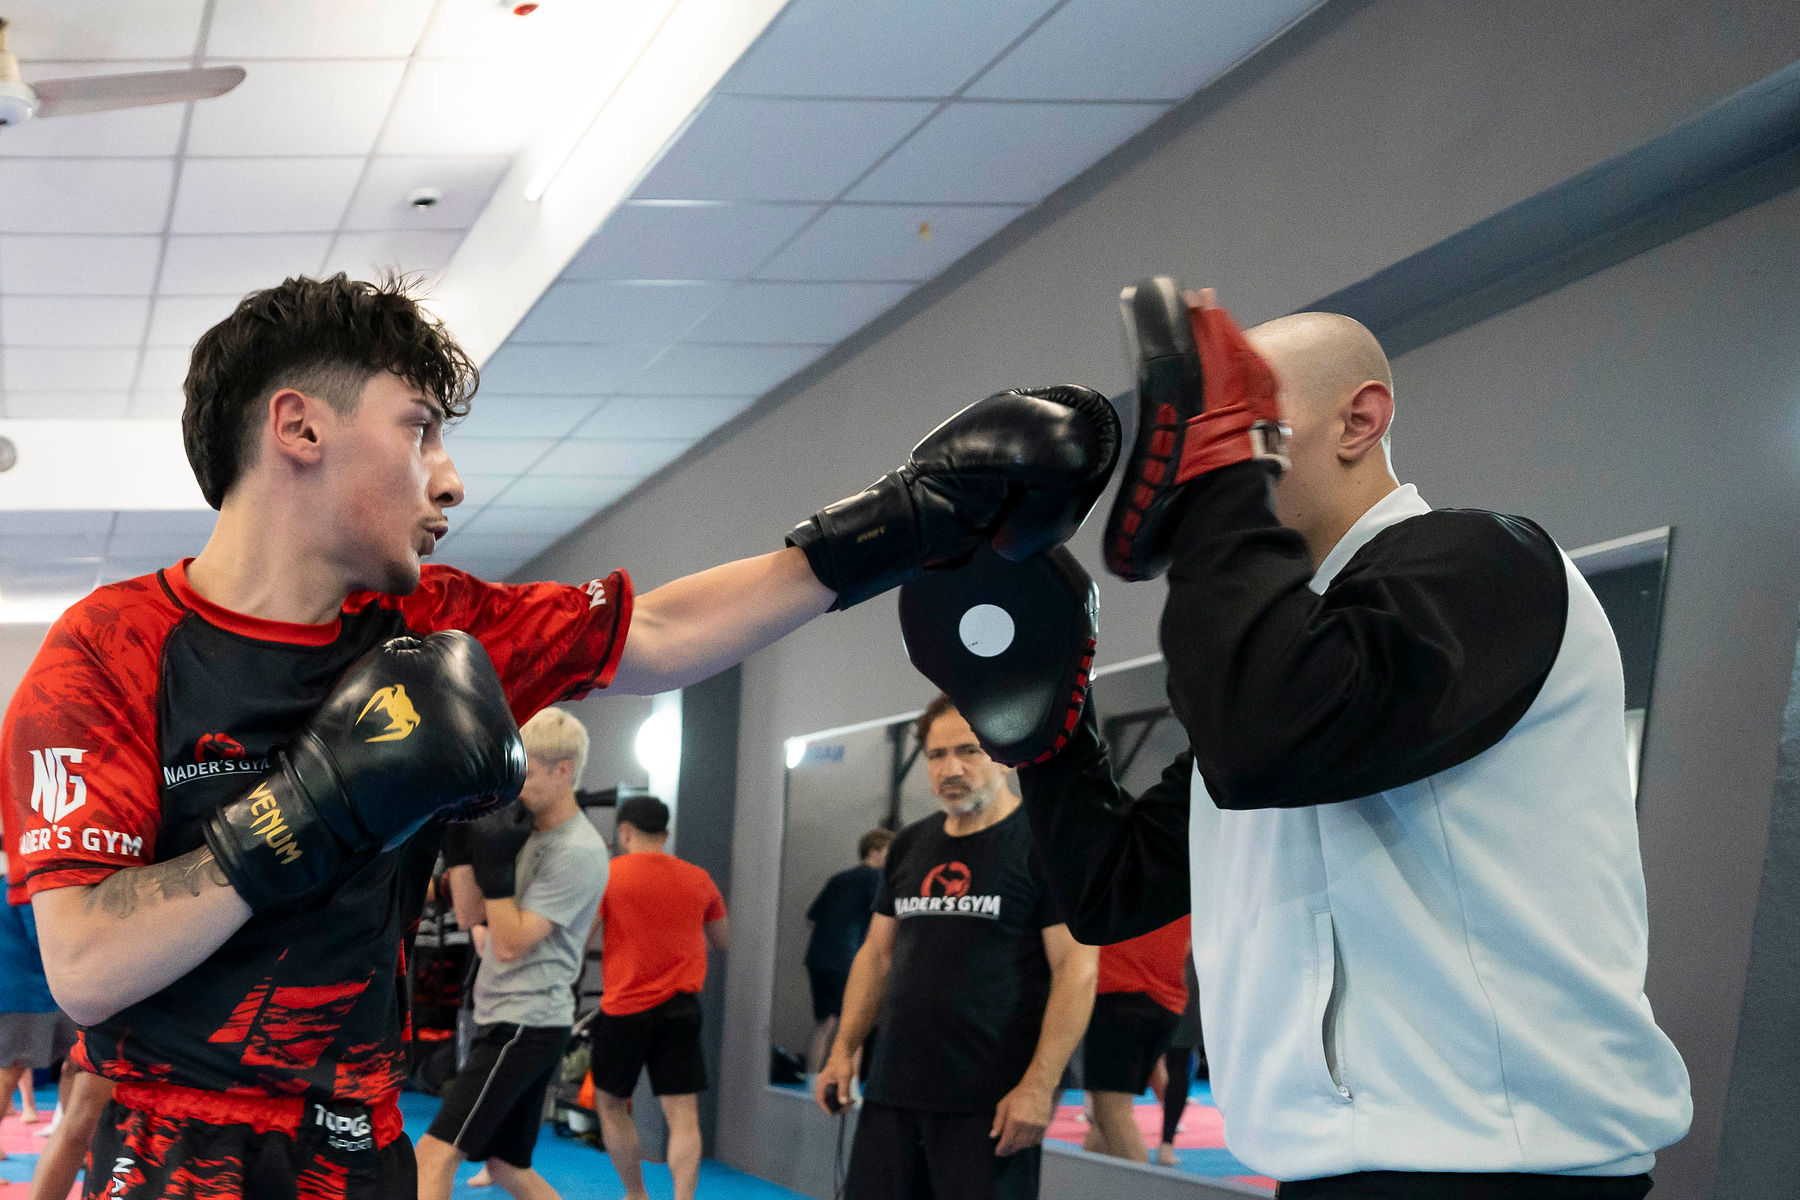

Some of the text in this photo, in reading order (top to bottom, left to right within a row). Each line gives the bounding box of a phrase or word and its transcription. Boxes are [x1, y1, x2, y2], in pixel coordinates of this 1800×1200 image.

[163, 759, 235, 786] NADER'S
[247, 781, 303, 865] VENUM
[81, 827, 143, 857] GYM
[957, 895, 1001, 918] GYM
